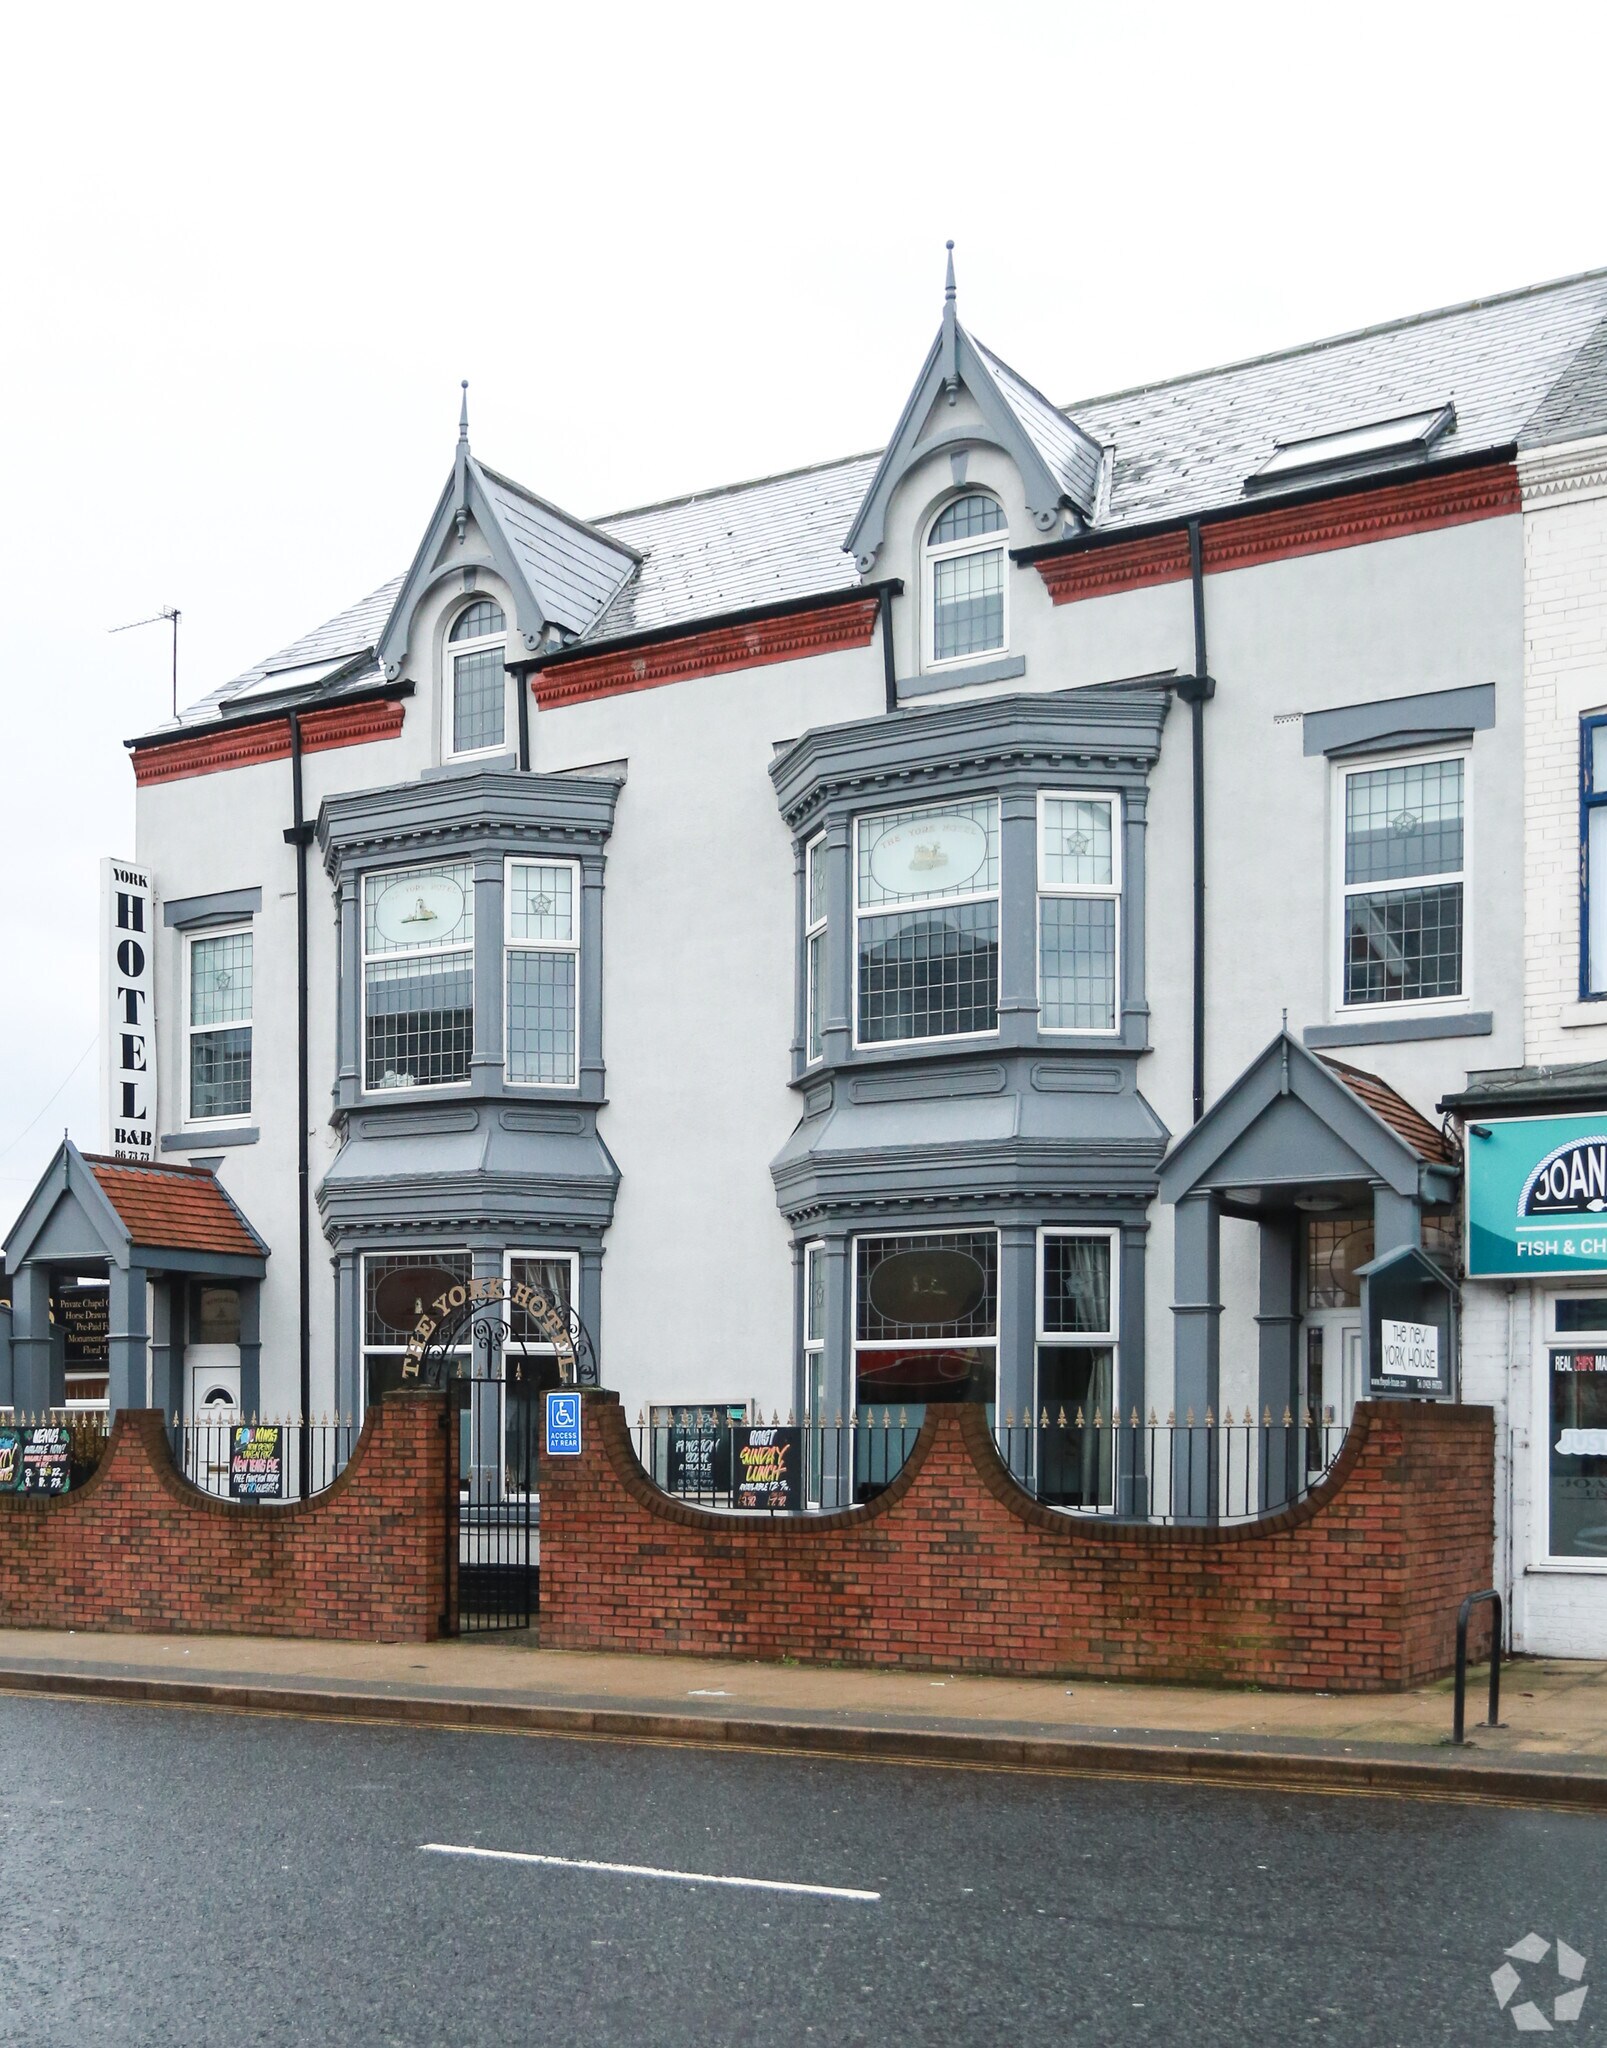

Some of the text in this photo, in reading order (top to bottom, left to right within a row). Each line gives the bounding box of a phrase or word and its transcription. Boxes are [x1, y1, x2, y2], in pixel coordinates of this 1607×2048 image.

[113, 868, 148, 888] YORK
[115, 891, 147, 1120] HOTEL
[114, 1128, 152, 1146] B&B
[115, 1149, 150, 1162] 86 73 73
[1535, 1146, 1606, 1200] JOAN
[1517, 1238, 1606, 1256] FISH & CH
[60, 1299, 82, 1309] Private
[83, 1298, 105, 1310] Chapel
[66, 1311, 84, 1320] Horse
[85, 1310, 107, 1320] Drawn
[76, 1322, 101, 1331] Pre-Paid
[402, 1277, 576, 1379] THE YORK HOTEL
[83, 1345, 101, 1354] Floral
[1384, 1344, 1435, 1371] YORK HOUSE
[1555, 1355, 1573, 1371] REAL
[1574, 1355, 1594, 1371] CHIPS
[33, 1428, 59, 1443] MENUS
[749, 1429, 777, 1446] ROAST
[740, 1444, 790, 1465] SUNDAY
[746, 1460, 787, 1482] LUNCH
